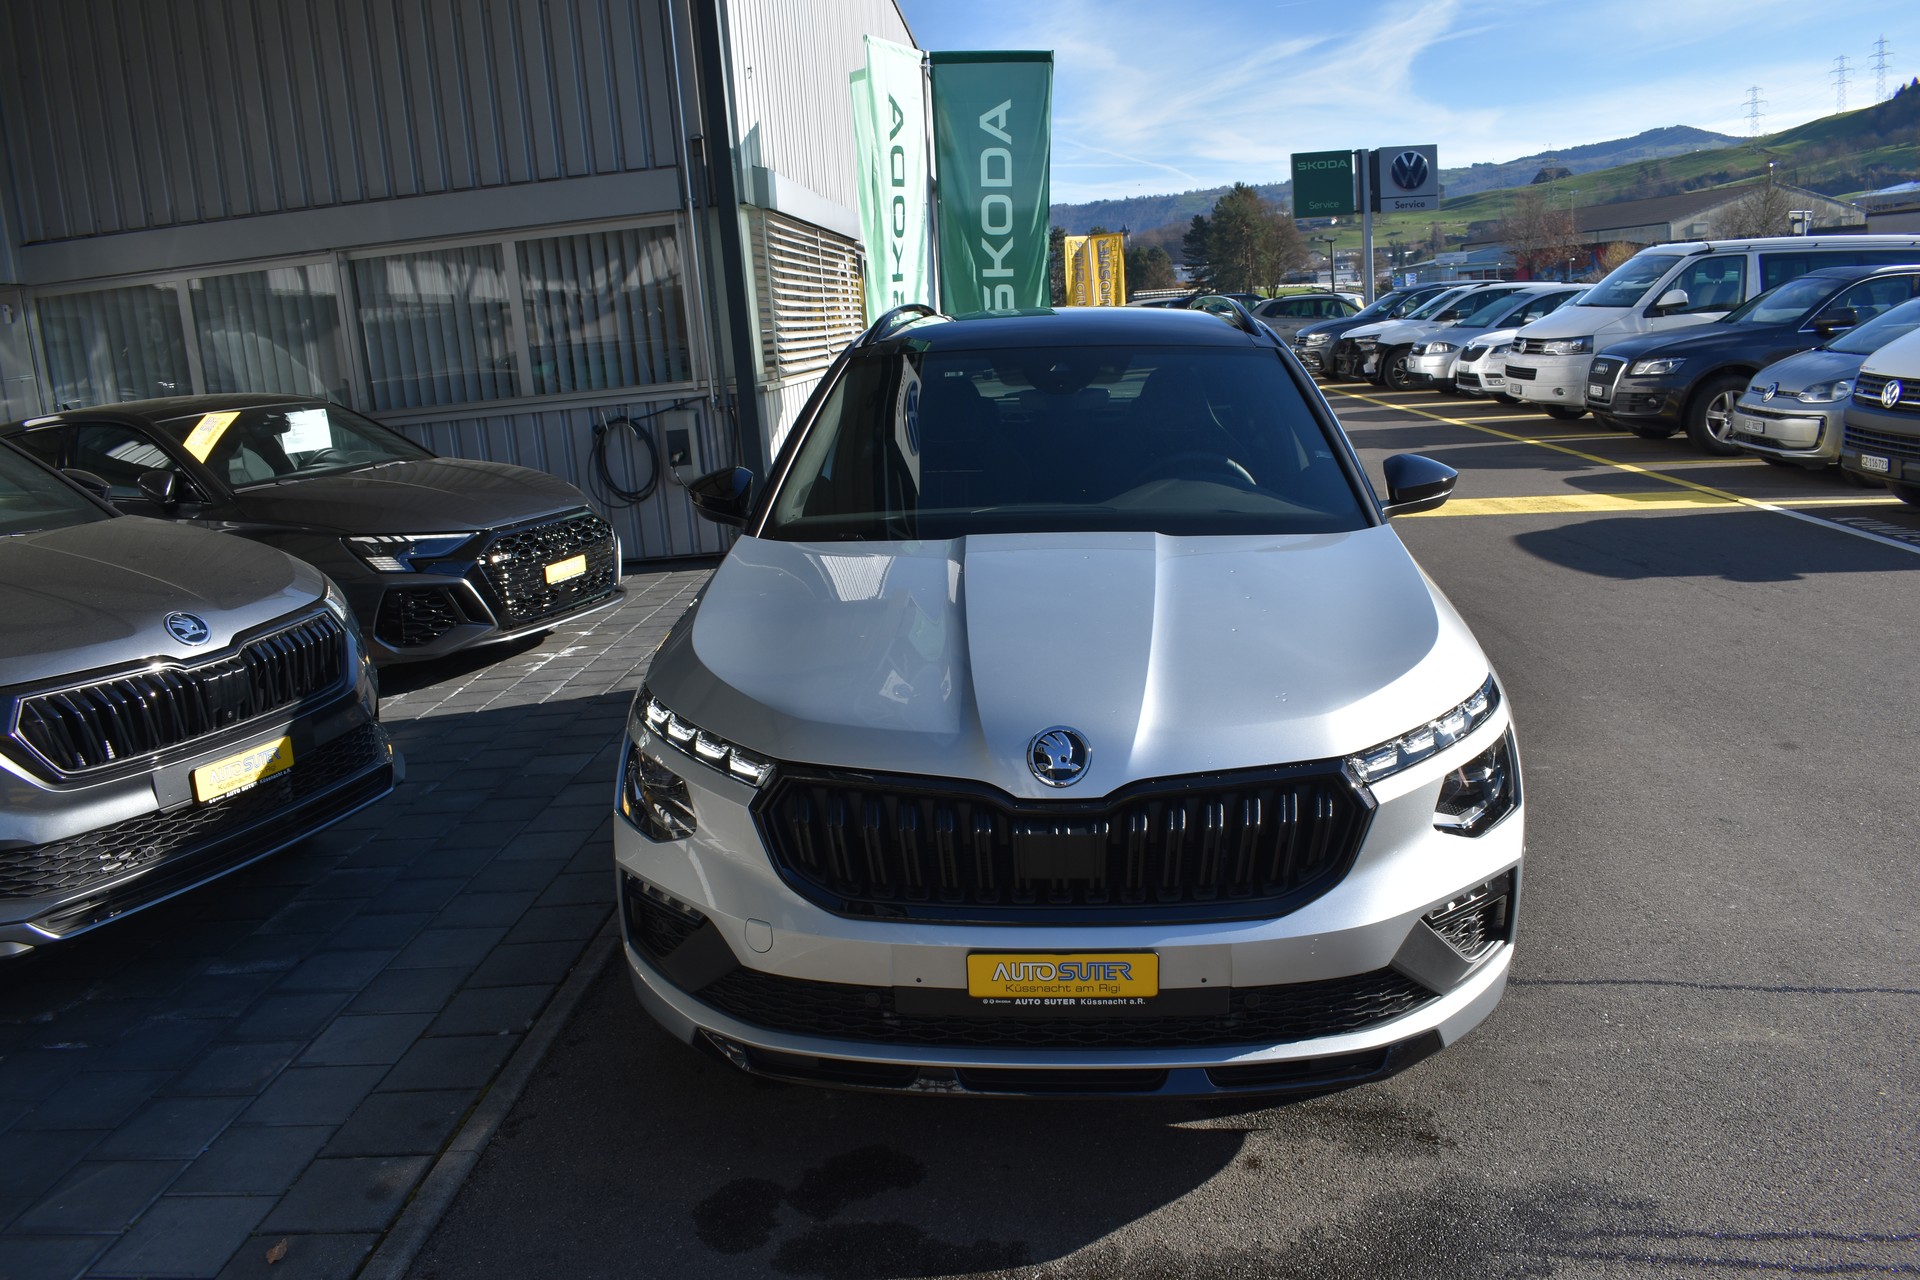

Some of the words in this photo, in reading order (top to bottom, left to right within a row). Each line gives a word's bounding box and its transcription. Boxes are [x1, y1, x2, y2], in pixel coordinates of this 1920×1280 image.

[1308, 200, 1340, 210] Service
[1394, 200, 1426, 209] Service
[1006, 984, 1071, 993] Küssnacht
[1099, 984, 1121, 994] Rigi
